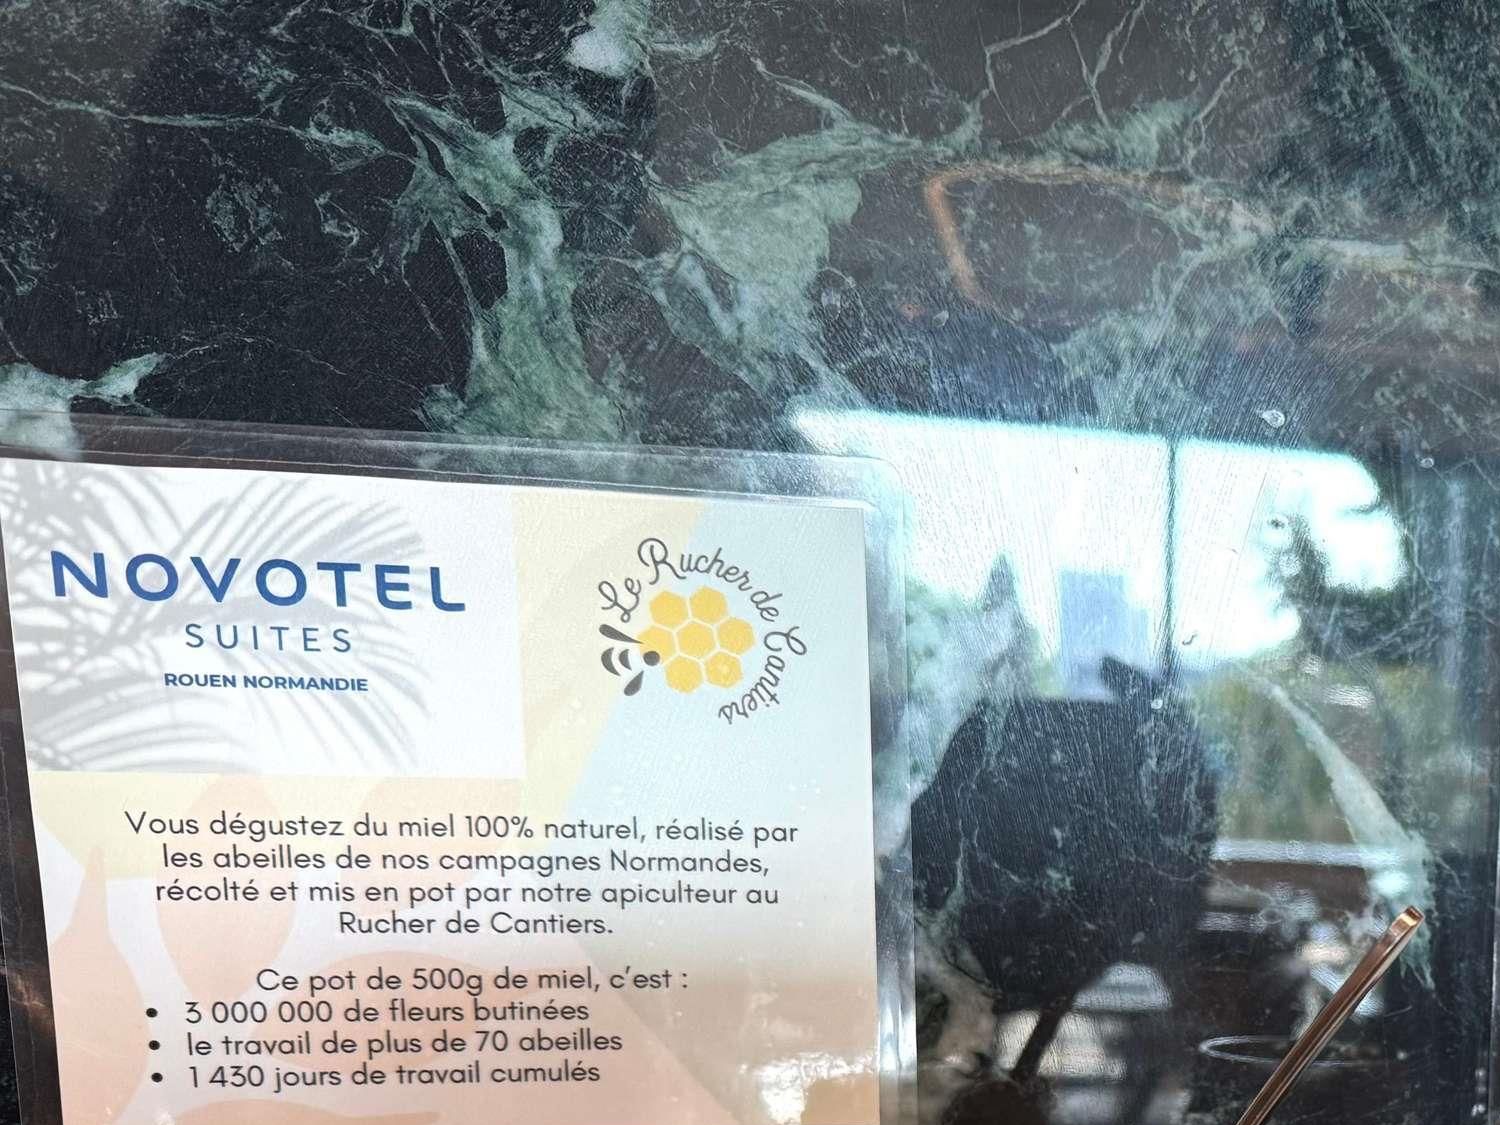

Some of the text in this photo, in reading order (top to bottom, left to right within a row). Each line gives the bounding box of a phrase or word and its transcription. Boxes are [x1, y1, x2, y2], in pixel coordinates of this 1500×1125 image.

[50, 550, 465, 612] NOVOTEL
[185, 623, 352, 654] SUITES
[599, 537, 807, 725] Le Rucher de Cantiers
[164, 673, 368, 692] ROUEN NORMANDIE
[125, 811, 799, 848] Vous dégustez du miel 100% naturel, réalisé par
[163, 844, 769, 878] les abeilles de nos campagnes Normandes,
[256, 967, 672, 997] Ce pot de 500g de miel, c'est
[184, 998, 589, 1023] 3 000 000 de fleurs butinées
